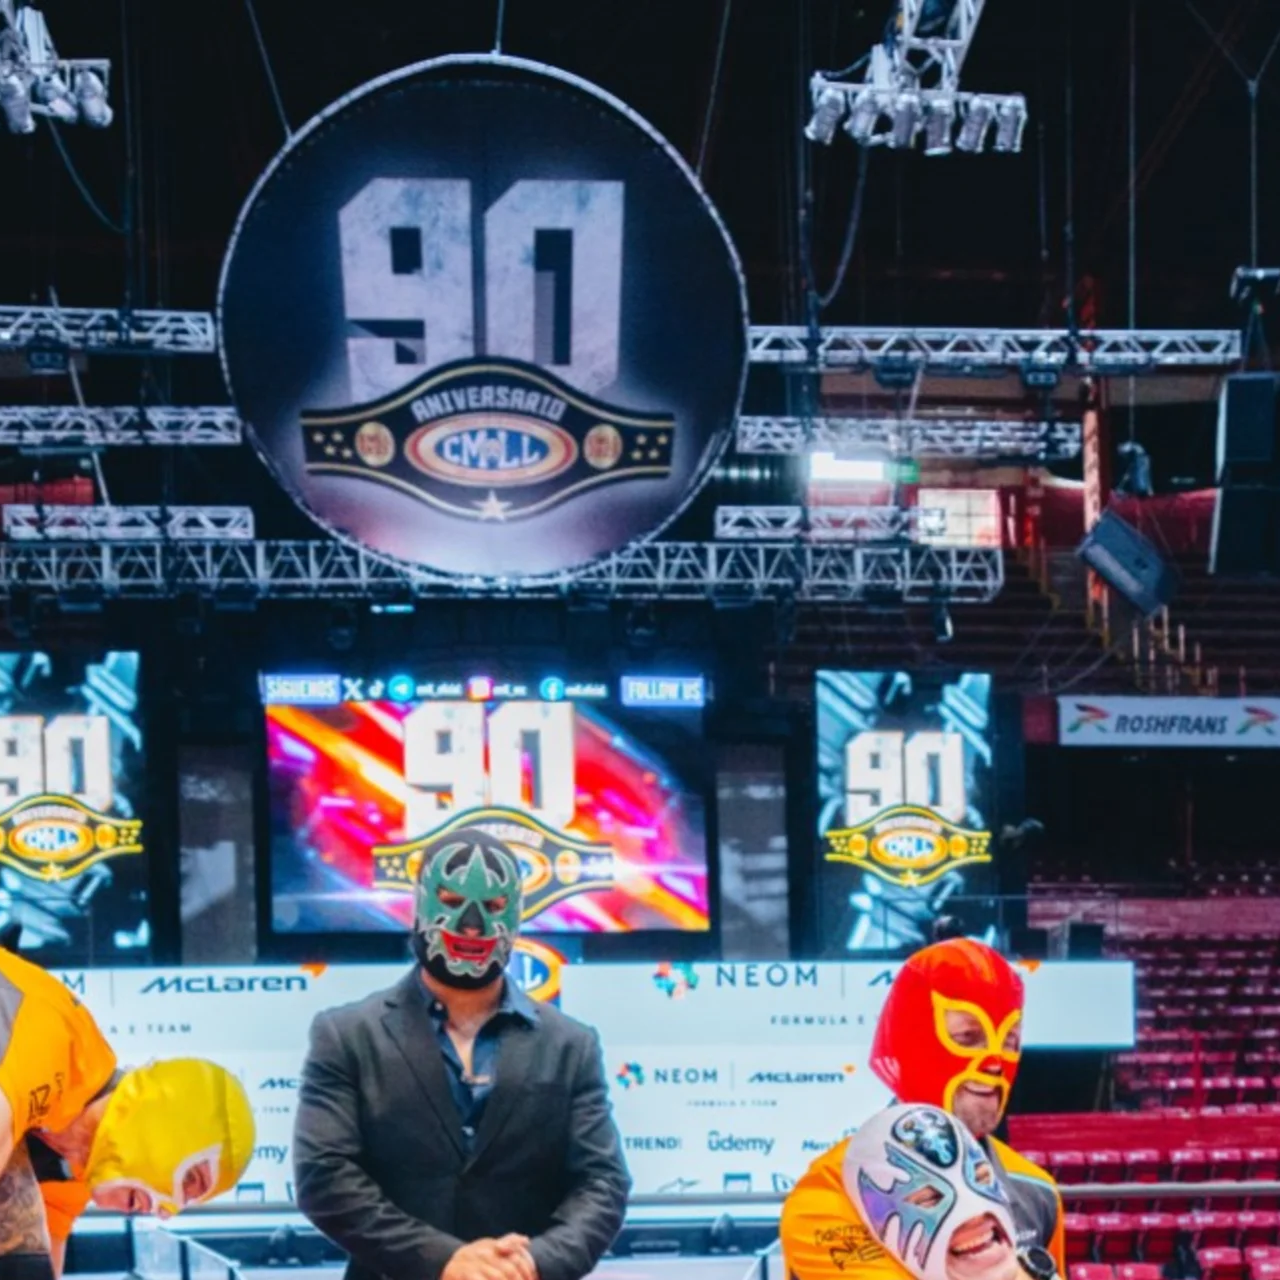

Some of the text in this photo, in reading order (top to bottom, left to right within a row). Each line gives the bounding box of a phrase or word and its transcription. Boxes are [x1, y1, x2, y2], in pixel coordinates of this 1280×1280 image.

[337, 177, 624, 402] 90
[410, 385, 567, 421] ANIVERSARIO
[443, 429, 544, 470] CMLL
[1115, 714, 1228, 735] ROSHFRANS
[403, 701, 574, 838] 90
[846, 731, 965, 825] 90
[140, 975, 308, 994] McLaren
[715, 964, 819, 988] NEOM
[654, 1068, 844, 1084] NEOM McLaren
